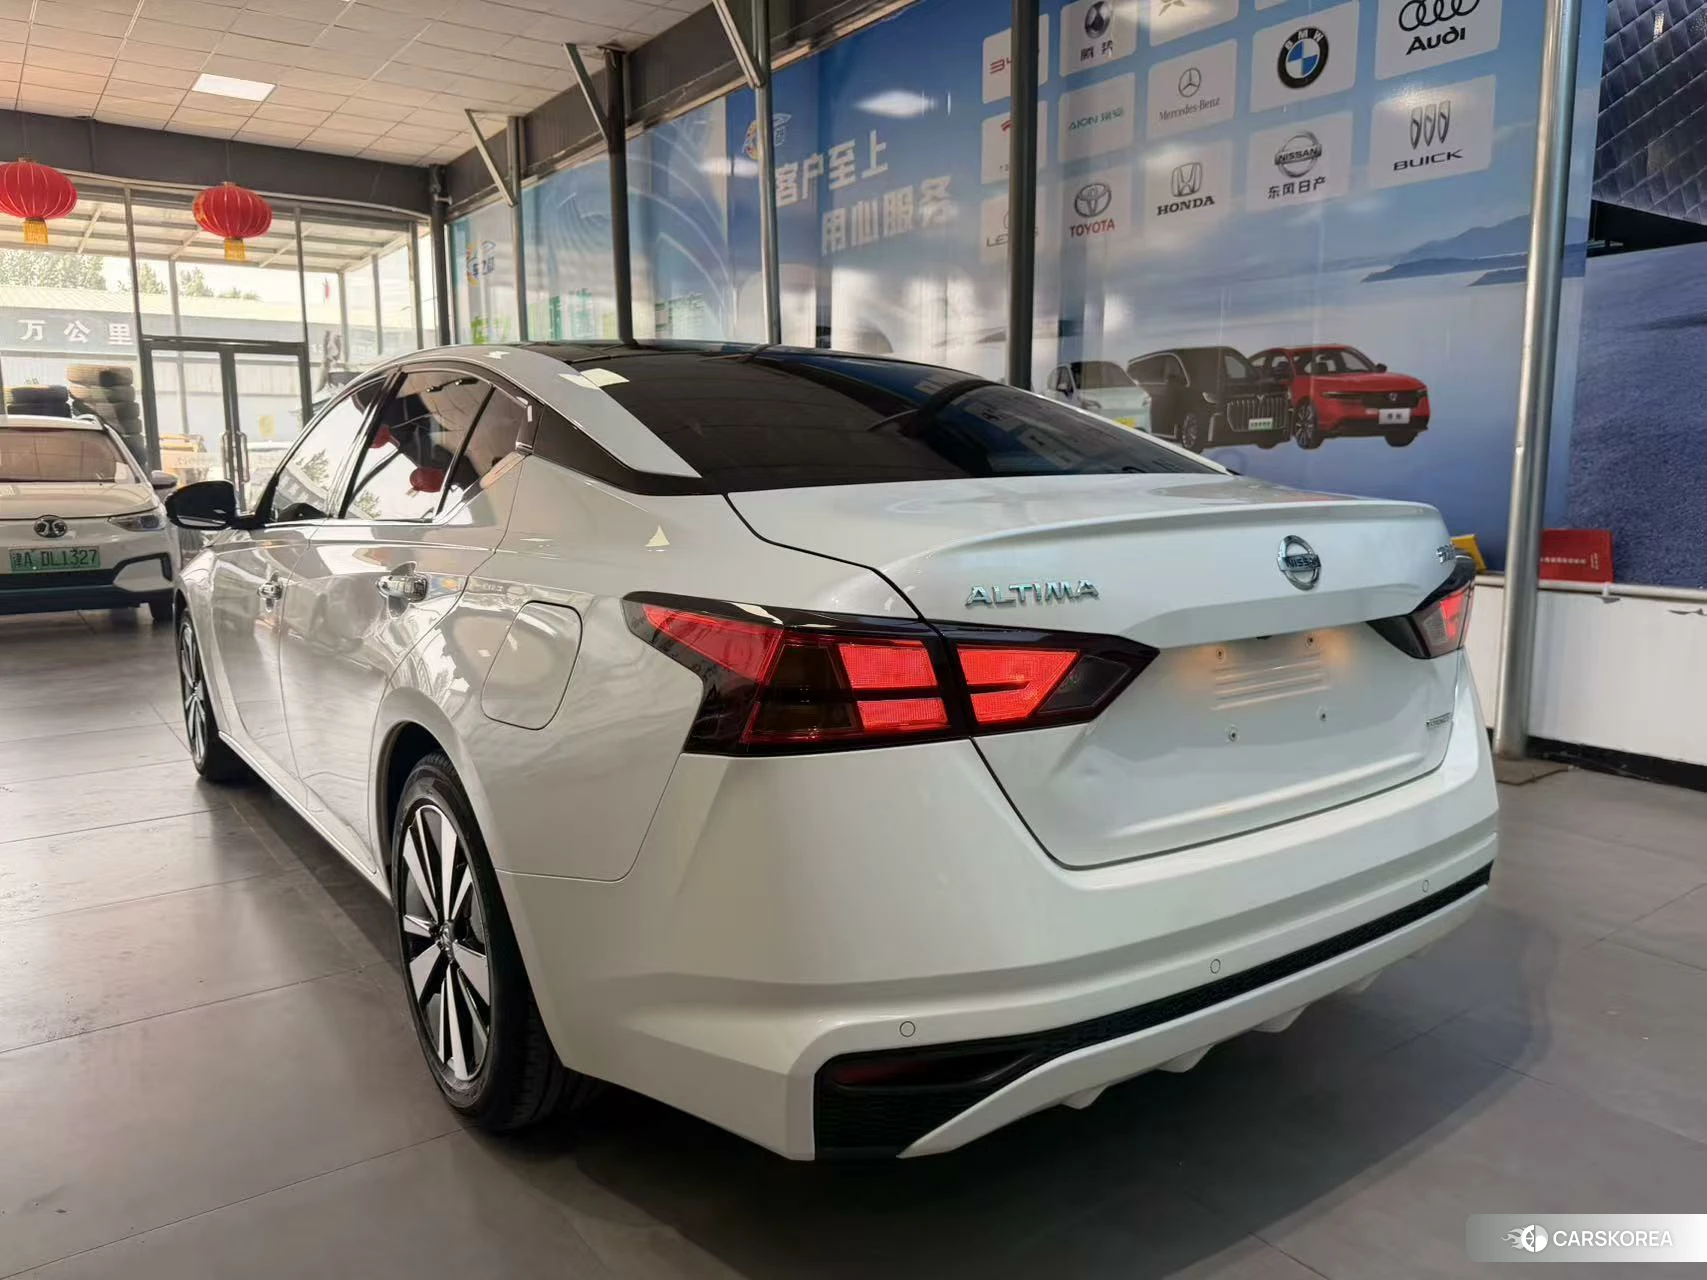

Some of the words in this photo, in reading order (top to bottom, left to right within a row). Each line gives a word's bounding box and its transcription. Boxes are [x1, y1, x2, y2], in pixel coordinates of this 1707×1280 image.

[1284, 29, 1324, 51] BMW
[1406, 27, 1466, 55] Audi
[1159, 97, 1220, 121] Mercedes-Benz
[1278, 146, 1320, 162] NISSAN
[1393, 149, 1464, 172] BUICK
[775, 129, 888, 208] 客户至上
[1268, 176, 1326, 199] 东风日产
[822, 175, 953, 257] 用心服务
[1156, 195, 1216, 216] HONDA
[1069, 218, 1116, 238] TOYOTA
[18, 319, 133, 346] 万公里
[965, 577, 1100, 609] ALTIMA
